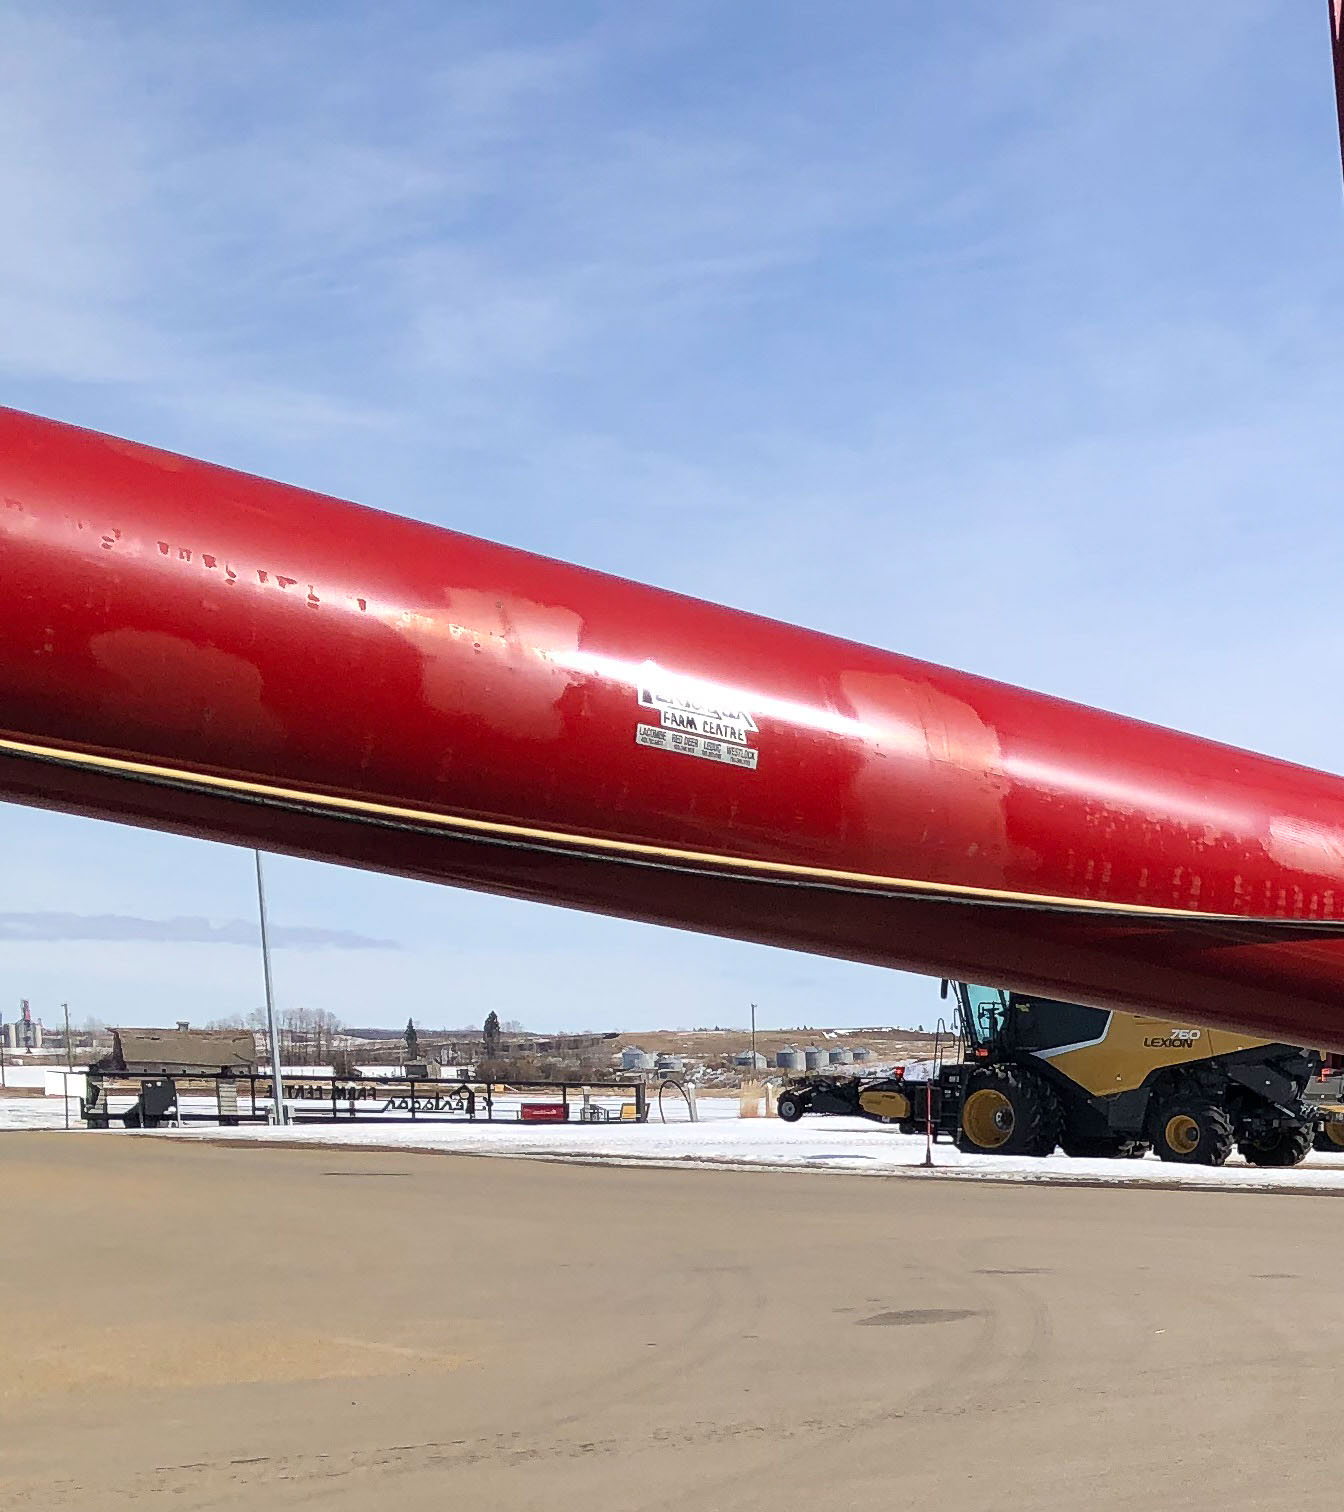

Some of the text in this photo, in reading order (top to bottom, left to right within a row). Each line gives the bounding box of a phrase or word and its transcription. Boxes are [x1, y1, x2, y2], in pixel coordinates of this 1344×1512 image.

[663, 711, 745, 741] FARM CENTRE
[1170, 1029, 1201, 1040] 760
[1143, 1037, 1194, 1049] LEXION
